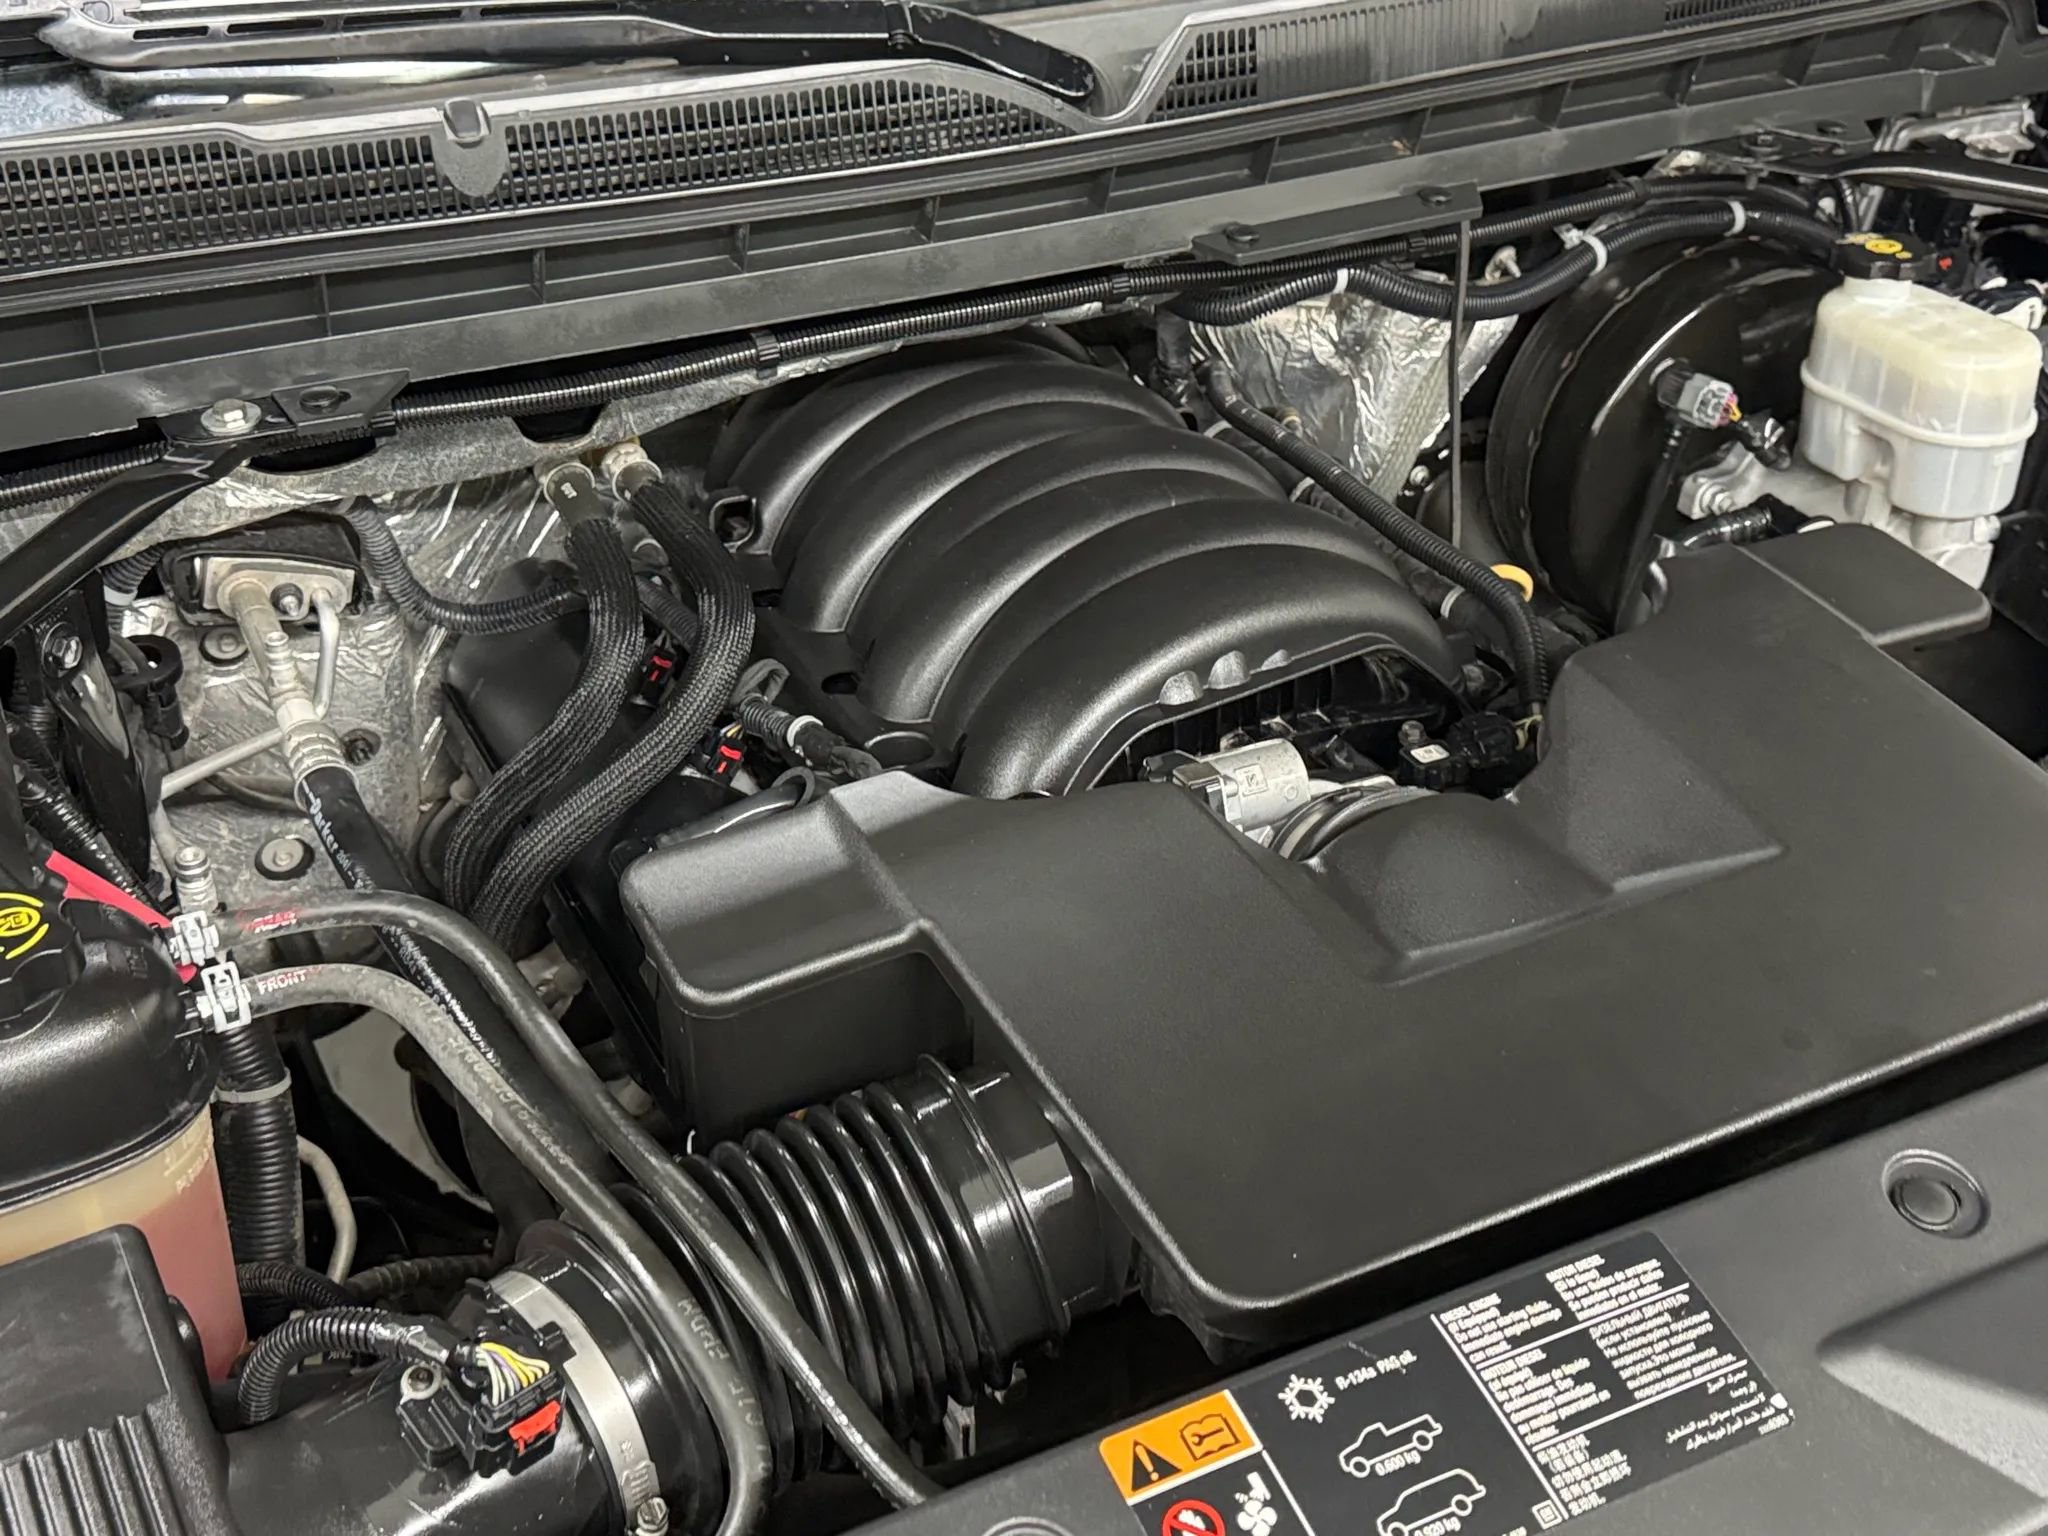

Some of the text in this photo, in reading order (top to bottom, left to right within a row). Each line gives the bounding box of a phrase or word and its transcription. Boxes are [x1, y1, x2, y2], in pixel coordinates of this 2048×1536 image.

[256, 969, 307, 995] FRONT
[1374, 1450, 1421, 1477] 0.600 kg
[1442, 1516, 1461, 1531] kg
